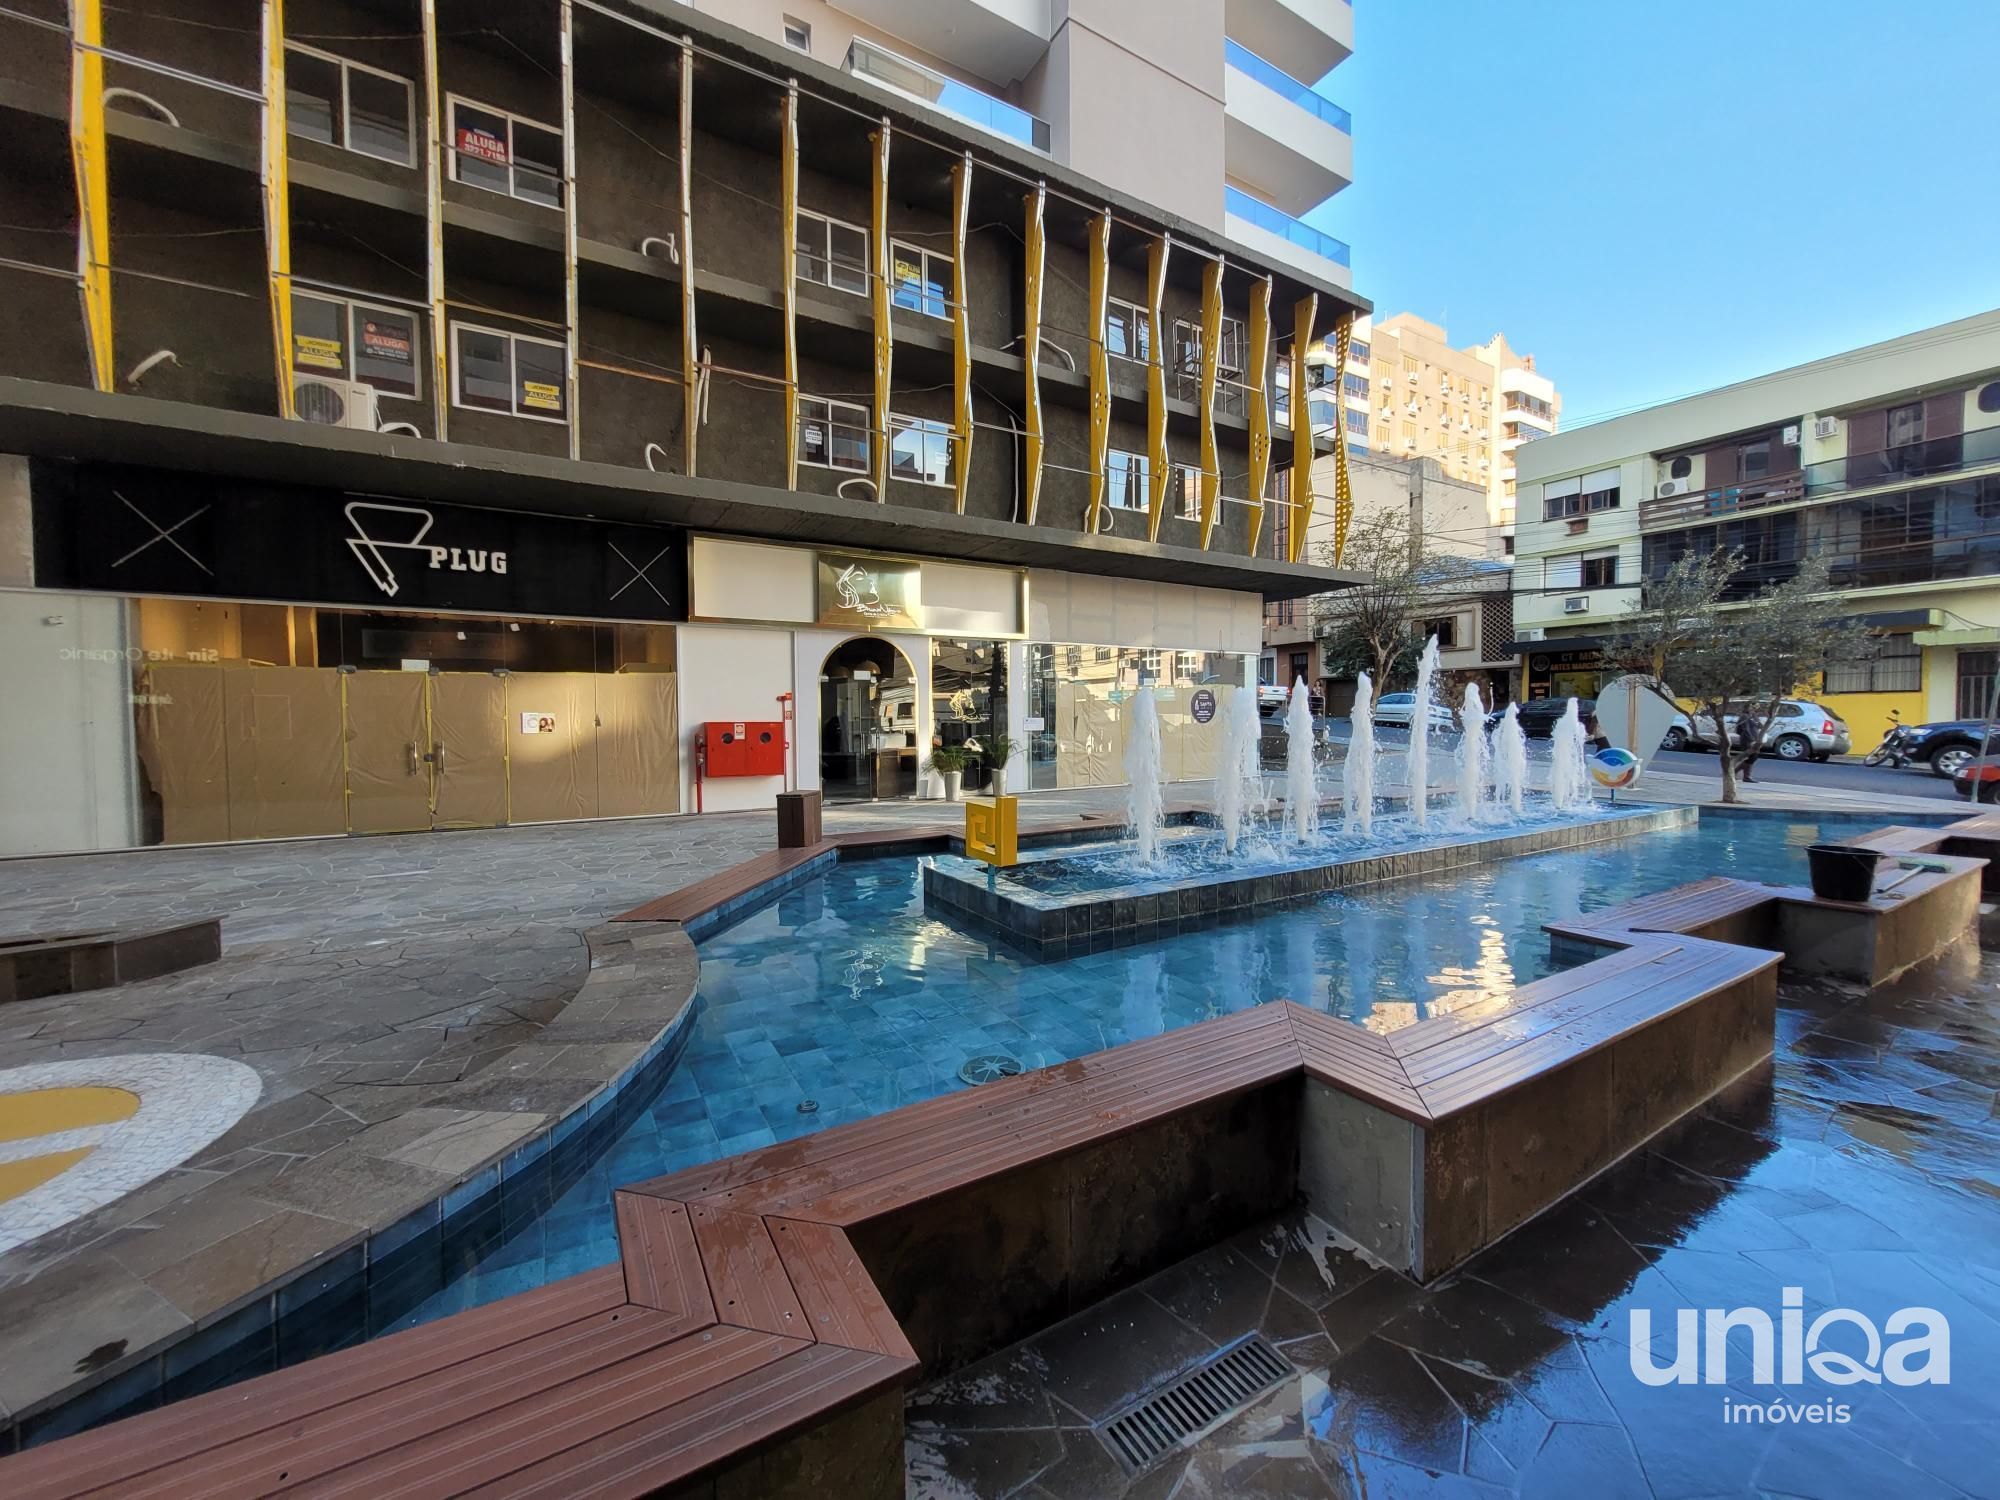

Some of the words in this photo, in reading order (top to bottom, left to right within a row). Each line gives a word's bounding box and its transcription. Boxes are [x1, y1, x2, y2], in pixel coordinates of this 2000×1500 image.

[465, 132, 505, 154] ALUGA
[373, 336, 405, 349] ALUGA
[302, 346, 337, 359] ALUGA
[529, 391, 556, 401] ALUGA
[429, 546, 507, 574] PLUG
